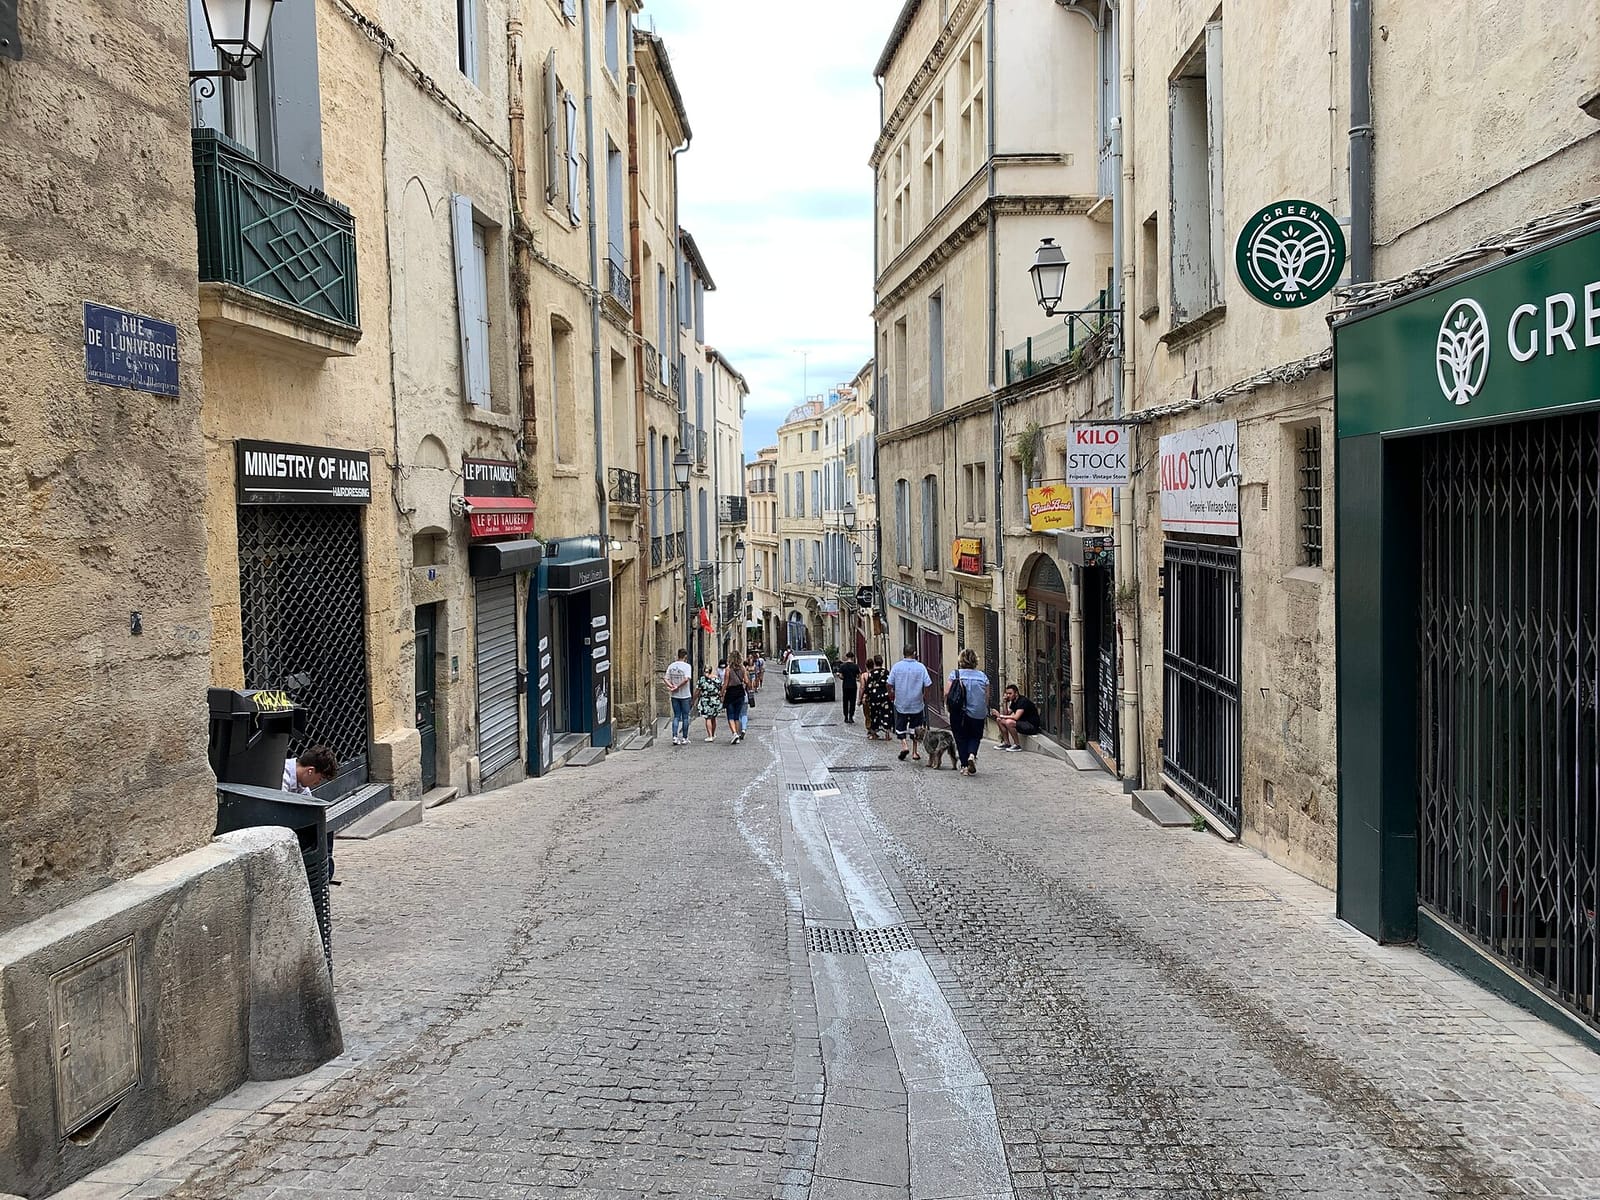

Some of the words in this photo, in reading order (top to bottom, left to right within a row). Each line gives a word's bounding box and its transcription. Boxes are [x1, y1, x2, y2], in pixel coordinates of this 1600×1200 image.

[1263, 205, 1320, 222] GREEN
[1273, 291, 1307, 302] OWL
[121, 315, 144, 336] RUE
[1507, 281, 1600, 362] GRE
[88, 327, 102, 347] DE
[1077, 429, 1119, 445] KILO
[245, 451, 315, 479] MINISTRY
[318, 457, 336, 480] OF
[339, 459, 370, 482] HAIR
[1069, 453, 1126, 469] STOCK
[465, 463, 475, 480] LE
[475, 464, 488, 481] P'TI
[489, 465, 517, 482] TAUREAU
[332, 487, 370, 498] HAIRDRESSING
[1207, 500, 1223, 516] Vintage
[1224, 500, 1237, 513] Store
[477, 514, 485, 527] LE
[487, 514, 499, 527] P'TI
[501, 513, 528, 526] TAUREAU
